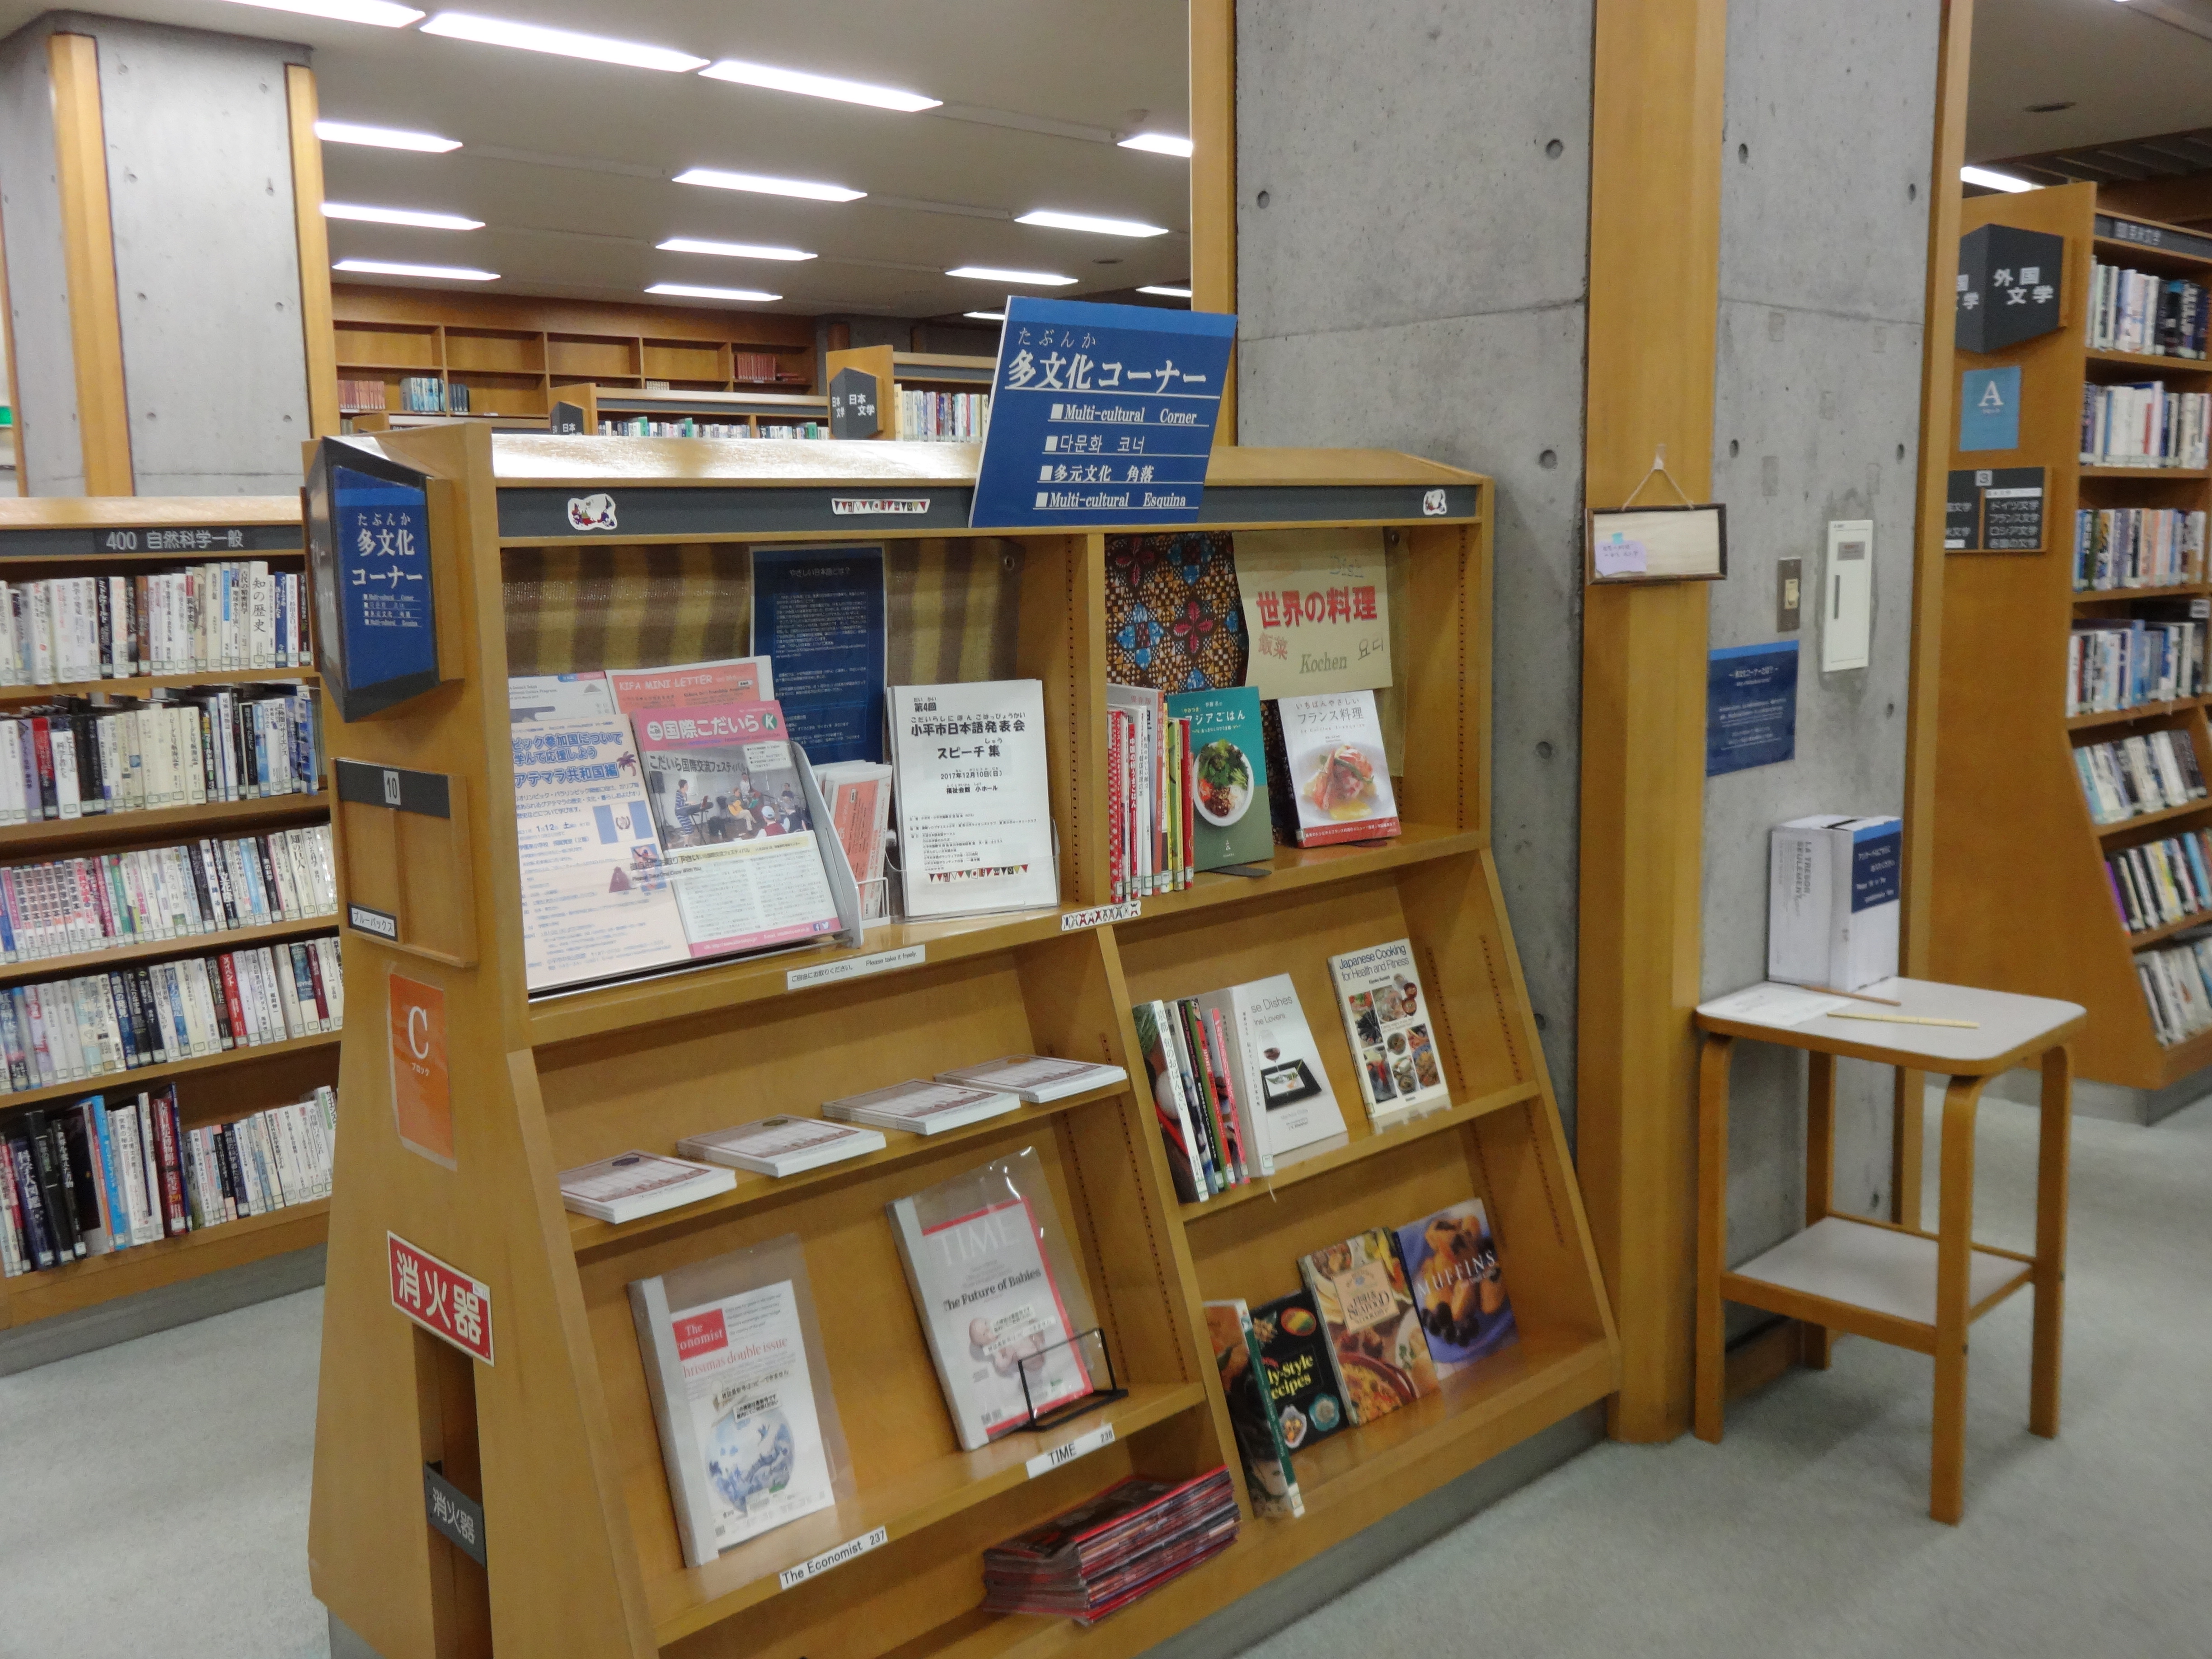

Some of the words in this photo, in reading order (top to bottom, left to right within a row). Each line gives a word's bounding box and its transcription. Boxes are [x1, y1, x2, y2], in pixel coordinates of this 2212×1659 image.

[1994, 267, 2040, 287] 外国
[2007, 286, 2053, 305] 文学
[1018, 327, 1096, 349] たぶんか
[1008, 349, 1206, 394] 多文化コーナー
[849, 394, 866, 405] 日本
[1979, 380, 2002, 407] A
[858, 405, 875, 416] 文学
[1064, 404, 1144, 423] Multi-cultural
[1160, 409, 1197, 424] Corner
[562, 423, 576, 433] 日本
[1060, 435, 1102, 453] 다문화
[1117, 435, 1145, 455] 코너
[1054, 464, 1112, 482] 多元文化
[1127, 466, 1154, 483] 角落
[1049, 492, 1129, 507] Multi-cultural
[1143, 493, 1186, 508] Esquina
[357, 511, 411, 526] たぶんか
[105, 531, 136, 550] 400
[147, 530, 244, 549] 自然科学一般
[357, 528, 415, 557] 多文化
[351, 565, 423, 588] コーナー
[253, 577, 266, 632] 知の歴史
[1257, 585, 1377, 629] 世界の料理
[1300, 652, 1347, 674] Kochen
[619, 681, 641, 690] KIFA
[674, 675, 712, 688] LETTER
[914, 703, 937, 712] 第4回
[1296, 698, 1359, 710] いちばんやさしい
[1185, 710, 1246, 725] アジアごはん
[1298, 707, 1364, 724] フランス料理
[662, 714, 759, 740] 国際こだいら
[911, 720, 1025, 736] 小平市日本語発表会
[513, 746, 597, 765] 学んで応援しよう
[937, 745, 1001, 759] スピーチ集
[515, 762, 619, 787] アテマラ共和国編
[387, 778, 397, 799] 10
[946, 786, 970, 794] 福祉会館
[353, 910, 393, 933] ブルーバックス
[866, 958, 884, 967] Please
[885, 955, 896, 963] take
[1340, 953, 1375, 970] Japanese
[1375, 945, 1406, 962] Cooking
[791, 964, 853, 983] ご自由にお取りください。
[1342, 971, 1351, 981] for
[1353, 965, 1373, 978] Health
[1374, 963, 1386, 974] and
[1387, 957, 1409, 970] Fitness
[1263, 996, 1293, 1010] Dishes
[1264, 1013, 1285, 1023] Lovers
[408, 1006, 428, 1059] C
[411, 1062, 430, 1076] ブロック
[1158, 1010, 1168, 1033] 京都
[1163, 1037, 1186, 1111] 旬のおばんざい
[930, 1215, 1020, 1266] TIME
[1417, 1251, 1496, 1299] MUFFINS
[397, 1250, 482, 1345] 消火器
[943, 1298, 961, 1311] The
[961, 1285, 996, 1306] Future
[998, 1278, 1008, 1291] of
[1008, 1268, 1041, 1288] Babies
[684, 1324, 703, 1337] The
[727, 1345, 760, 1365] double
[762, 1338, 787, 1353] issue
[1048, 1443, 1077, 1466] TIME
[433, 1487, 474, 1544] 消火器
[782, 1567, 805, 1586] The
[807, 1541, 863, 1576] Economist
[869, 1530, 886, 1546] 237
